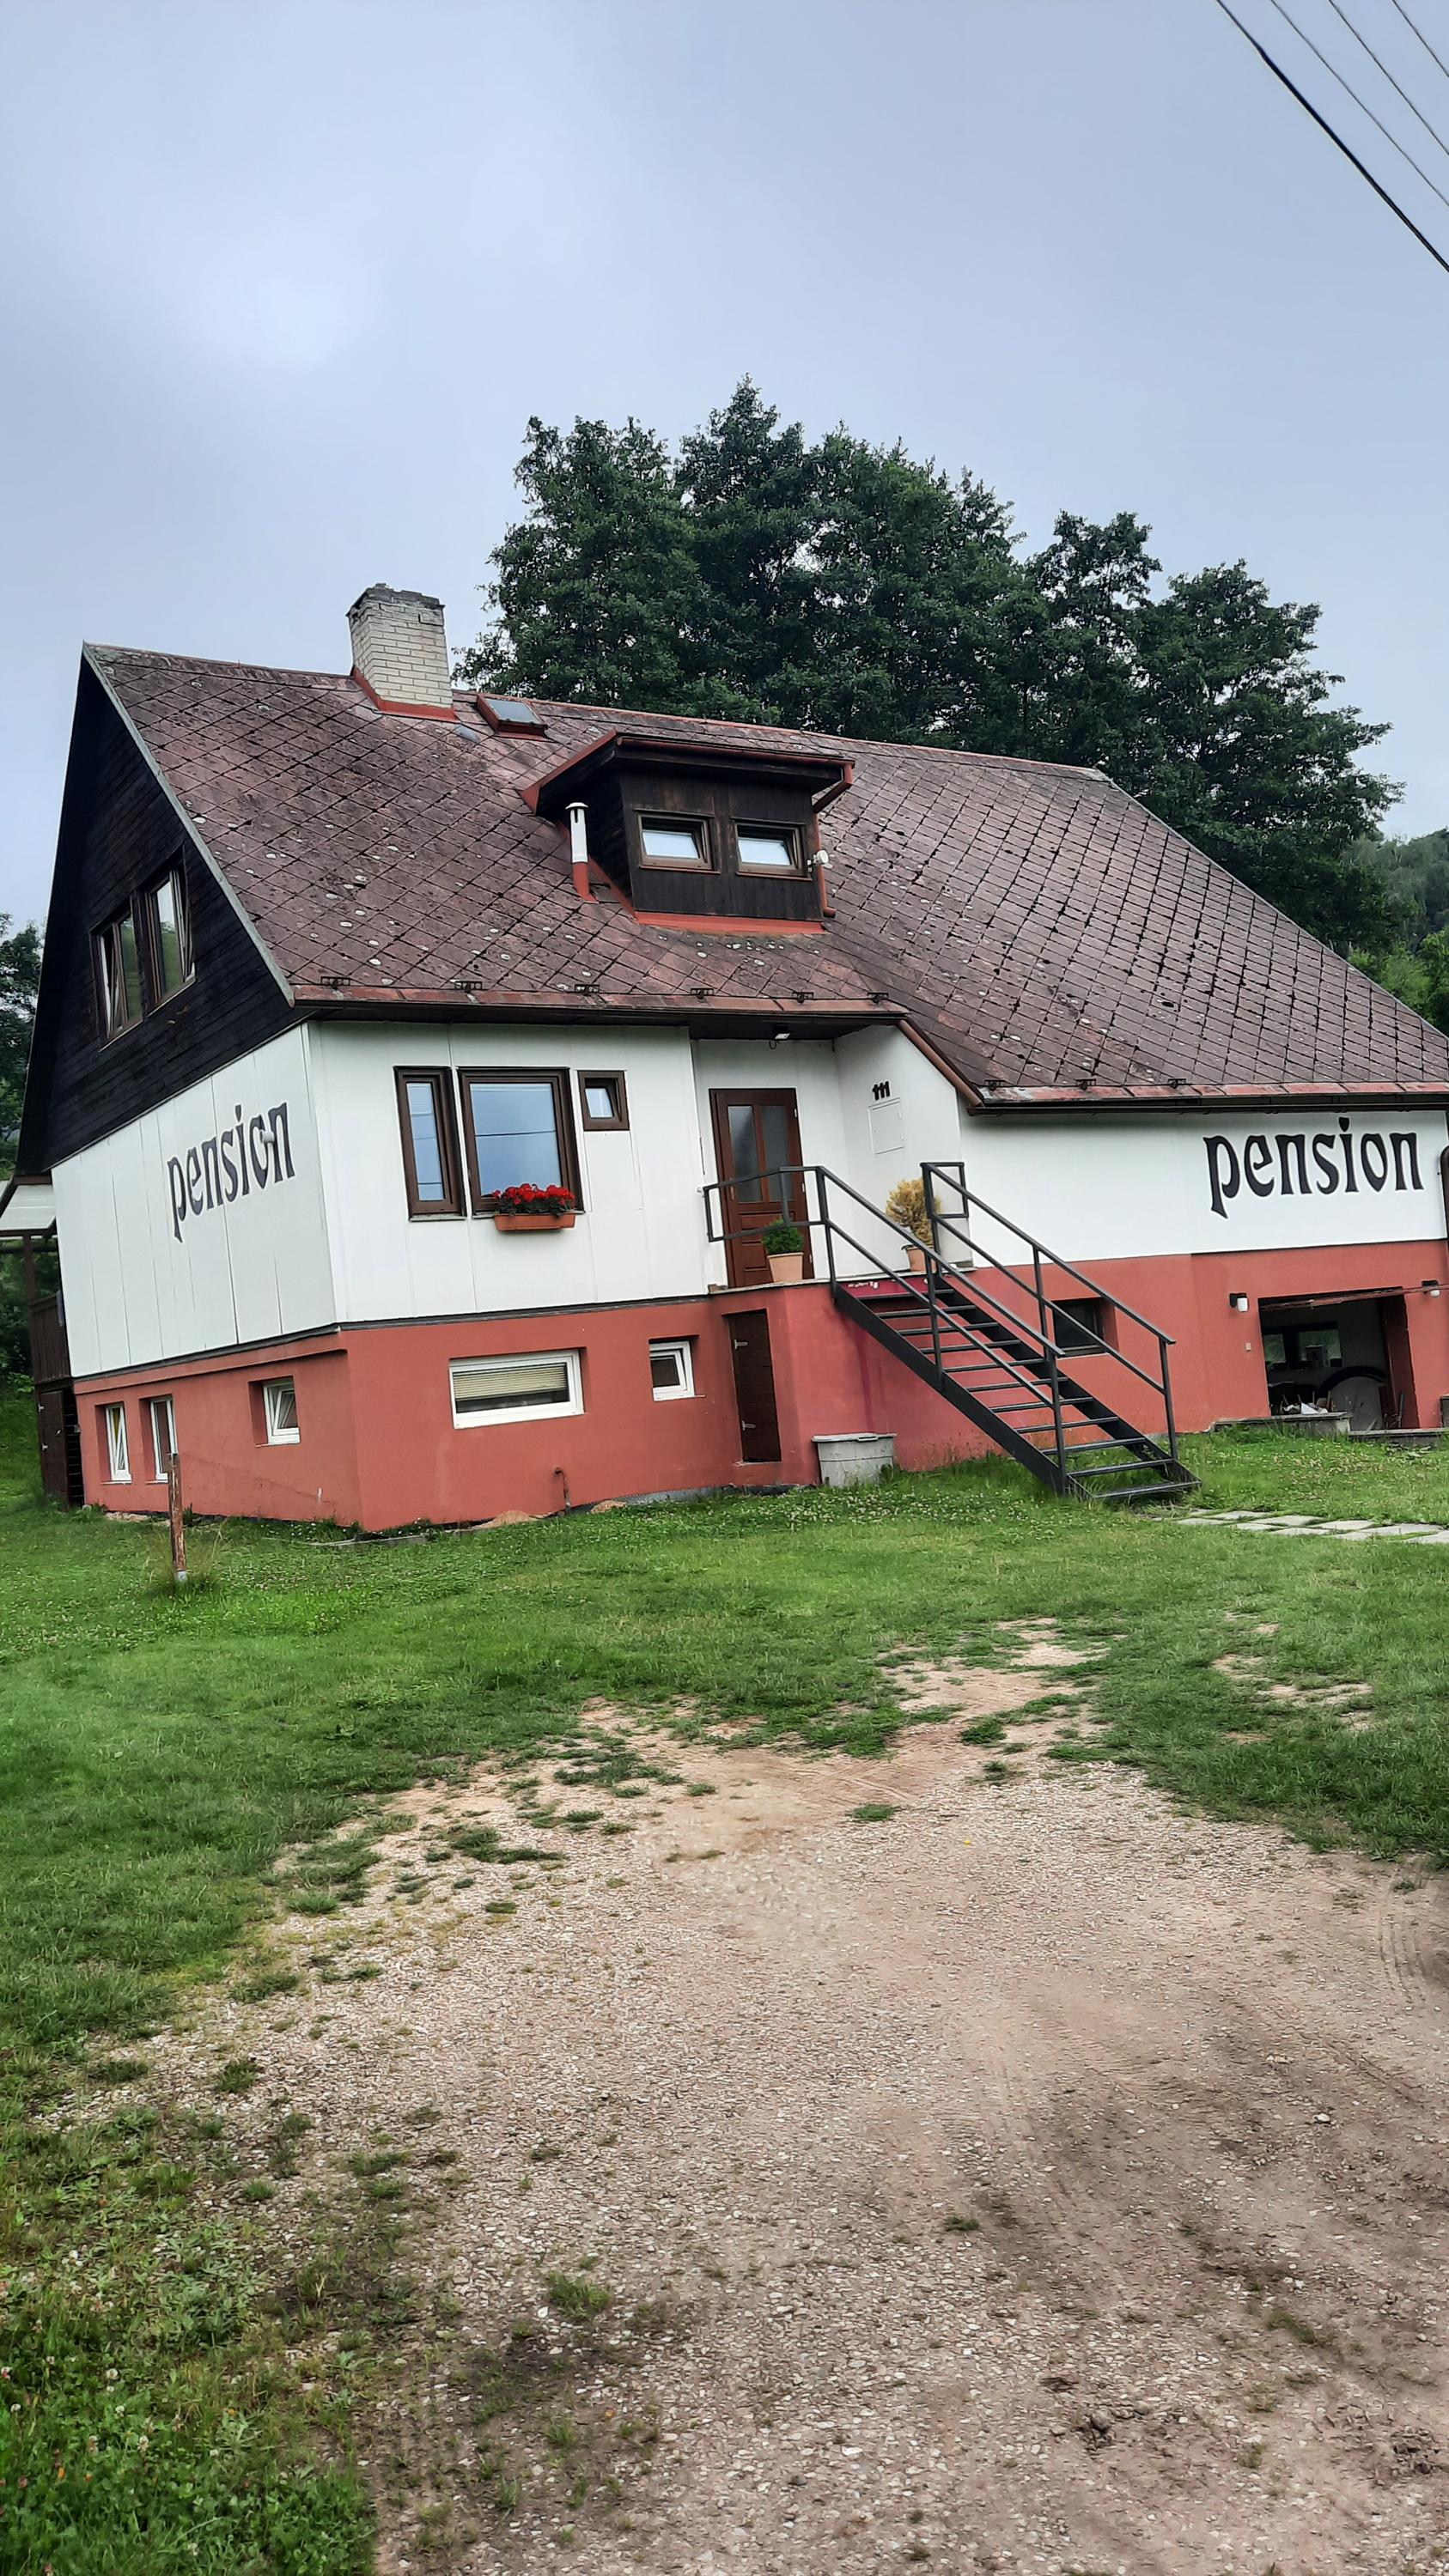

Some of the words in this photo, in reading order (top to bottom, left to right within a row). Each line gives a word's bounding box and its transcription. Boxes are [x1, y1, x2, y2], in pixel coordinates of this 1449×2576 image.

[872, 1081, 891, 1101] 111
[167, 1102, 295, 1242] pension
[1202, 1116, 1424, 1218] pension
